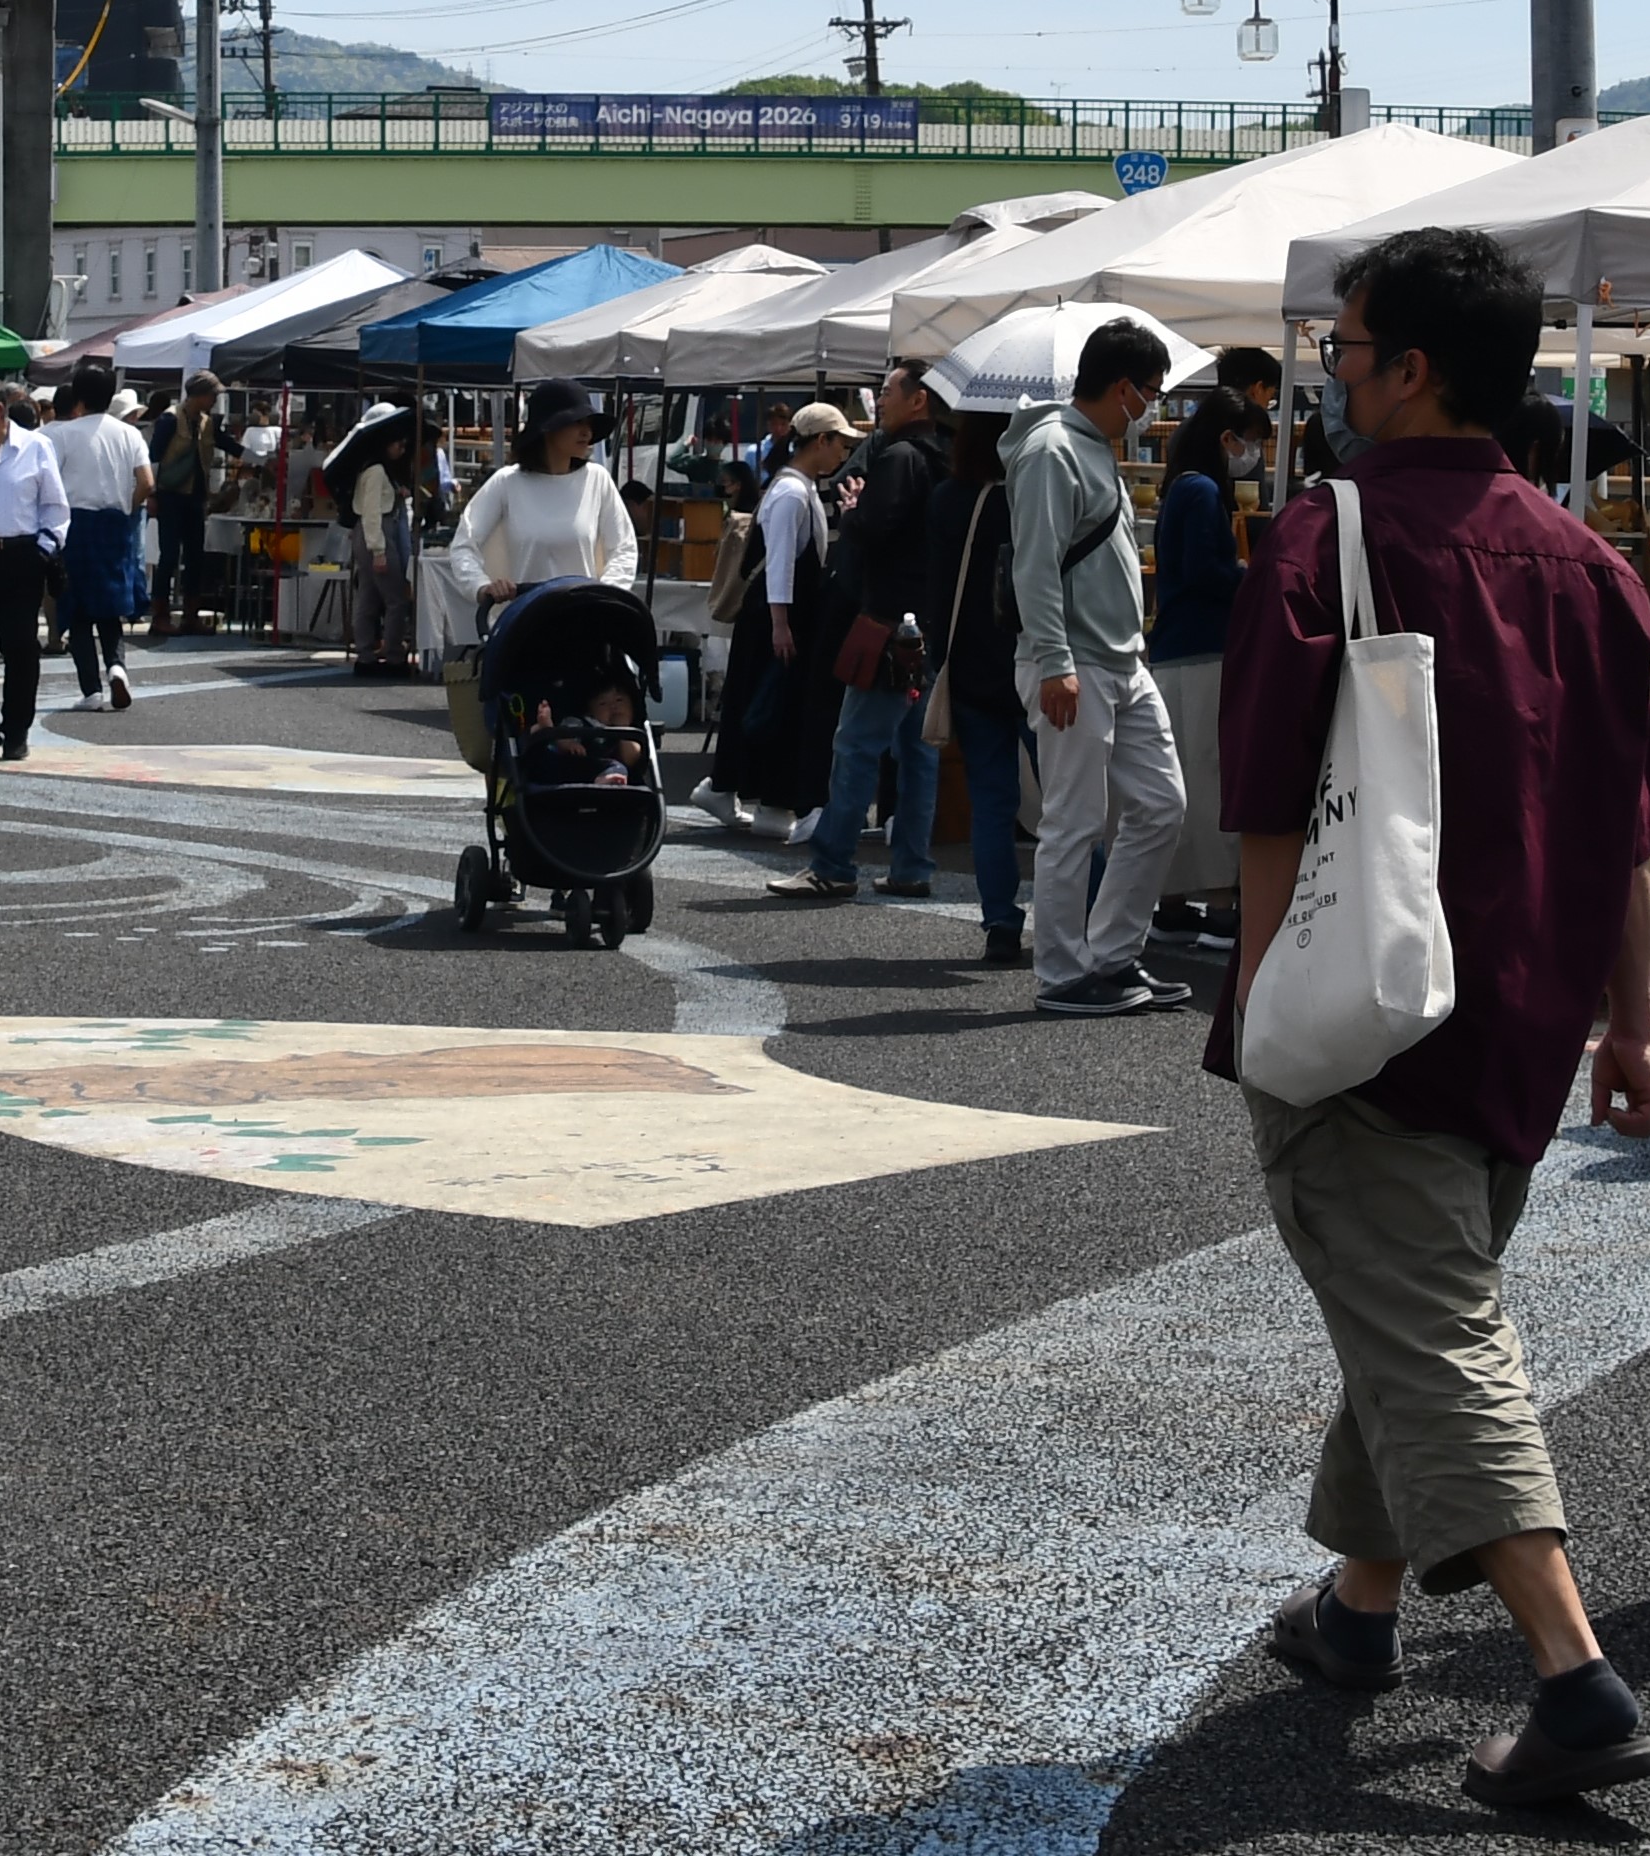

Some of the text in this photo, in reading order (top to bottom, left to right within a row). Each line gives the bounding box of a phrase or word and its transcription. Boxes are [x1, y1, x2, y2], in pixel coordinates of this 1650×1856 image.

[596, 104, 817, 129] Aichi-Nagoya 2026
[1122, 164, 1160, 185] 248
